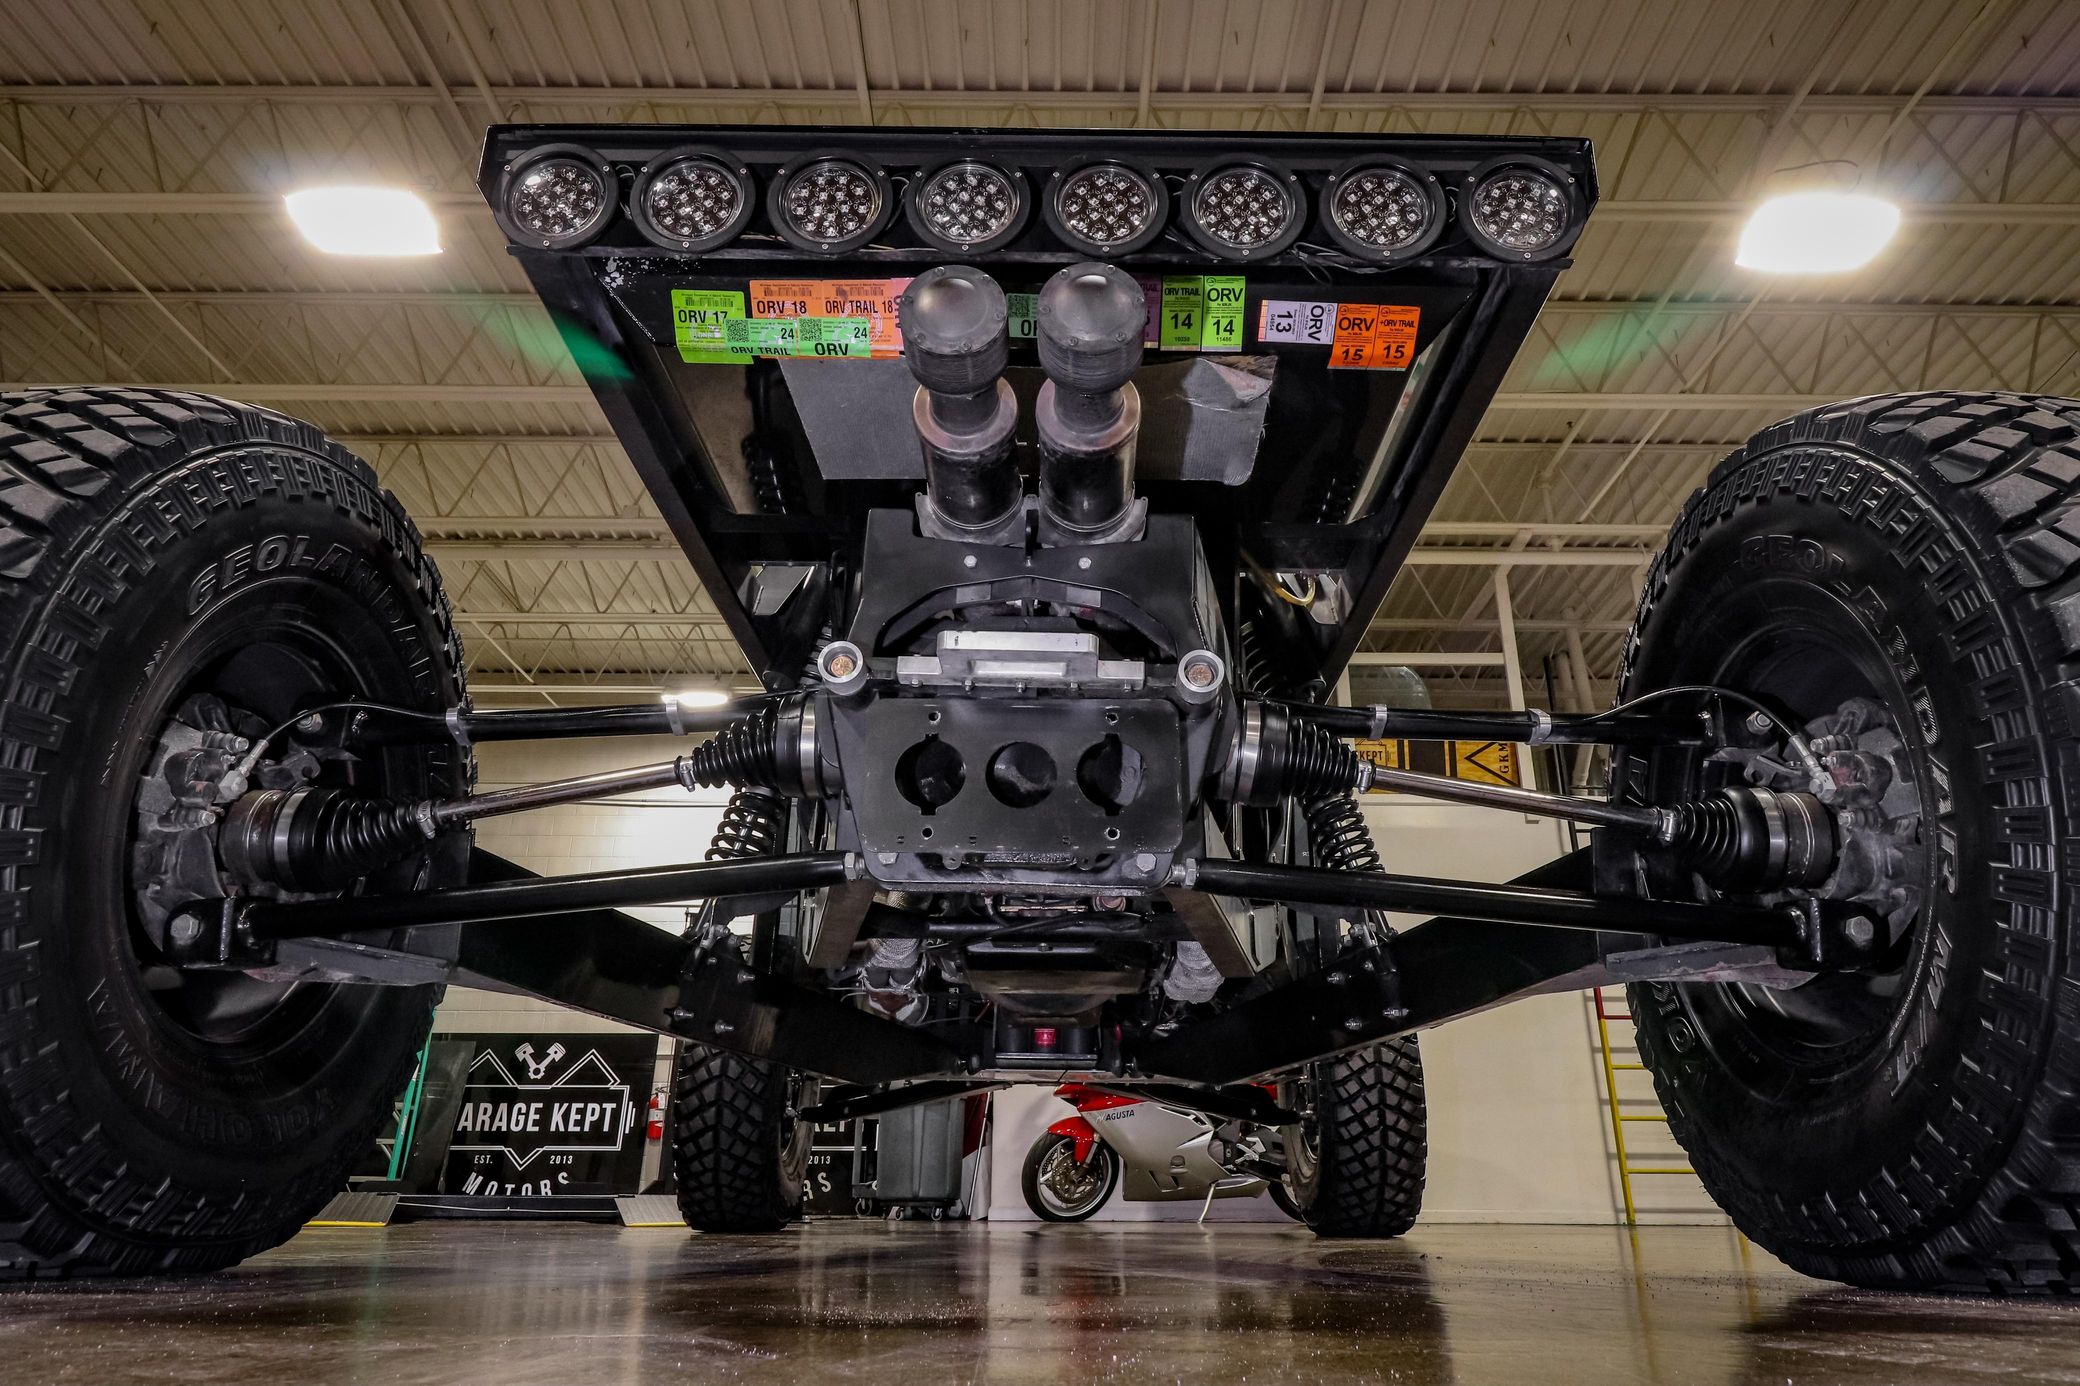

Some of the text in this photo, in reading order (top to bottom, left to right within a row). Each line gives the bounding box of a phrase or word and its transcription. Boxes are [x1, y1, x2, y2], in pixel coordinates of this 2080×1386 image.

[1164, 287, 1180, 296] ORV
[1181, 287, 1201, 297] TRAIL
[1206, 287, 1243, 302] ORV
[757, 300, 807, 314] ORV 18
[825, 300, 893, 313] ORV TRAIL 18
[678, 309, 728, 324] ORV 17
[1170, 312, 1193, 330] 14
[1275, 310, 1294, 333] 13
[1307, 304, 1325, 342] ORV
[1398, 319, 1415, 328] TRAIL
[1213, 319, 1235, 336] 14
[1338, 316, 1375, 332] ORV
[780, 327, 795, 340] 24
[854, 326, 868, 339] 24
[731, 346, 791, 356] ORV TRAIL
[814, 342, 849, 356] ORV
[1341, 347, 1364, 361] 15
[1383, 343, 1405, 359] 15
[1499, 742, 1510, 774] GKM
[456, 1102, 617, 1133] ARAGE KEPT
[1105, 1109, 1135, 1121] AGUSTA
[473, 1154, 493, 1164] EST.
[549, 1154, 574, 1165] 2013
[807, 1155, 831, 1165] 2013
